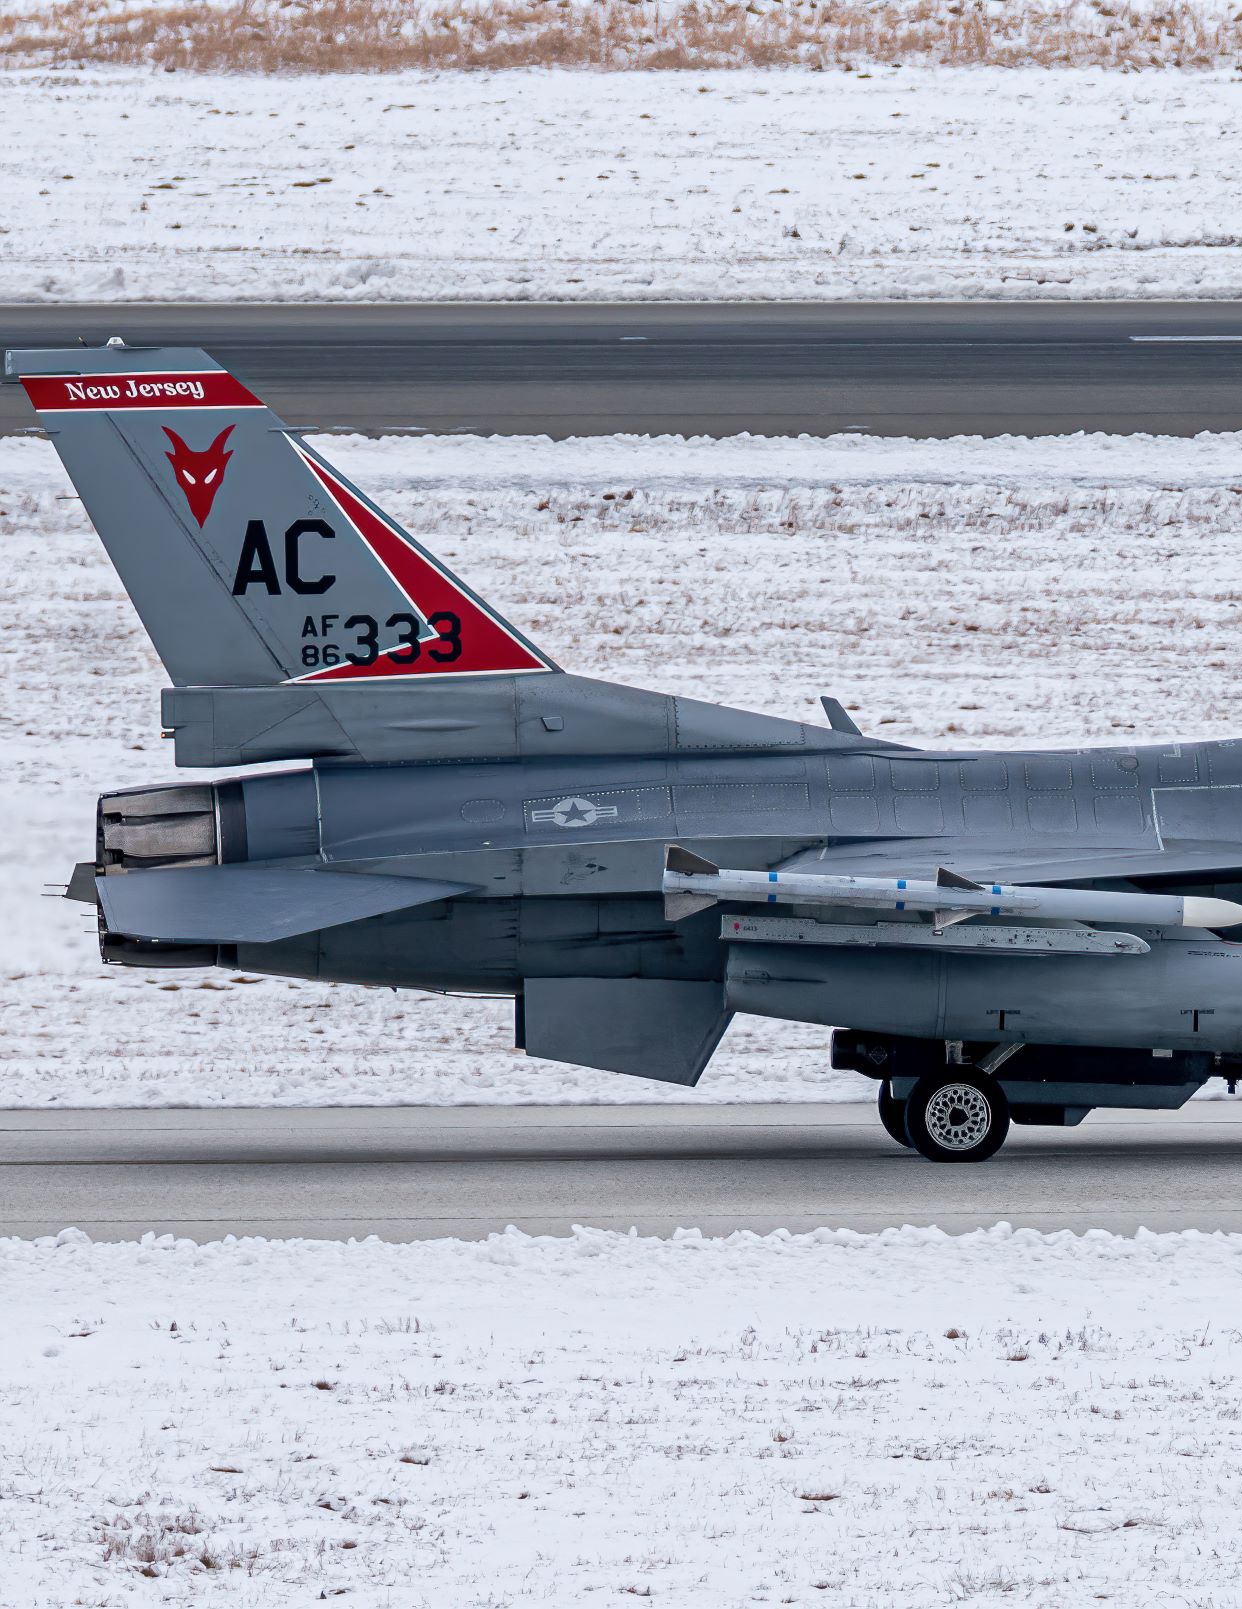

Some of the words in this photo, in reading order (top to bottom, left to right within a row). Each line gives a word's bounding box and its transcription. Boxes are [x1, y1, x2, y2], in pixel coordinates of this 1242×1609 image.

[64, 382, 120, 401] New
[125, 380, 205, 399] Jersey
[231, 519, 337, 596] AC
[301, 614, 340, 637] AF
[343, 611, 462, 666] 333
[301, 644, 340, 667] 86
